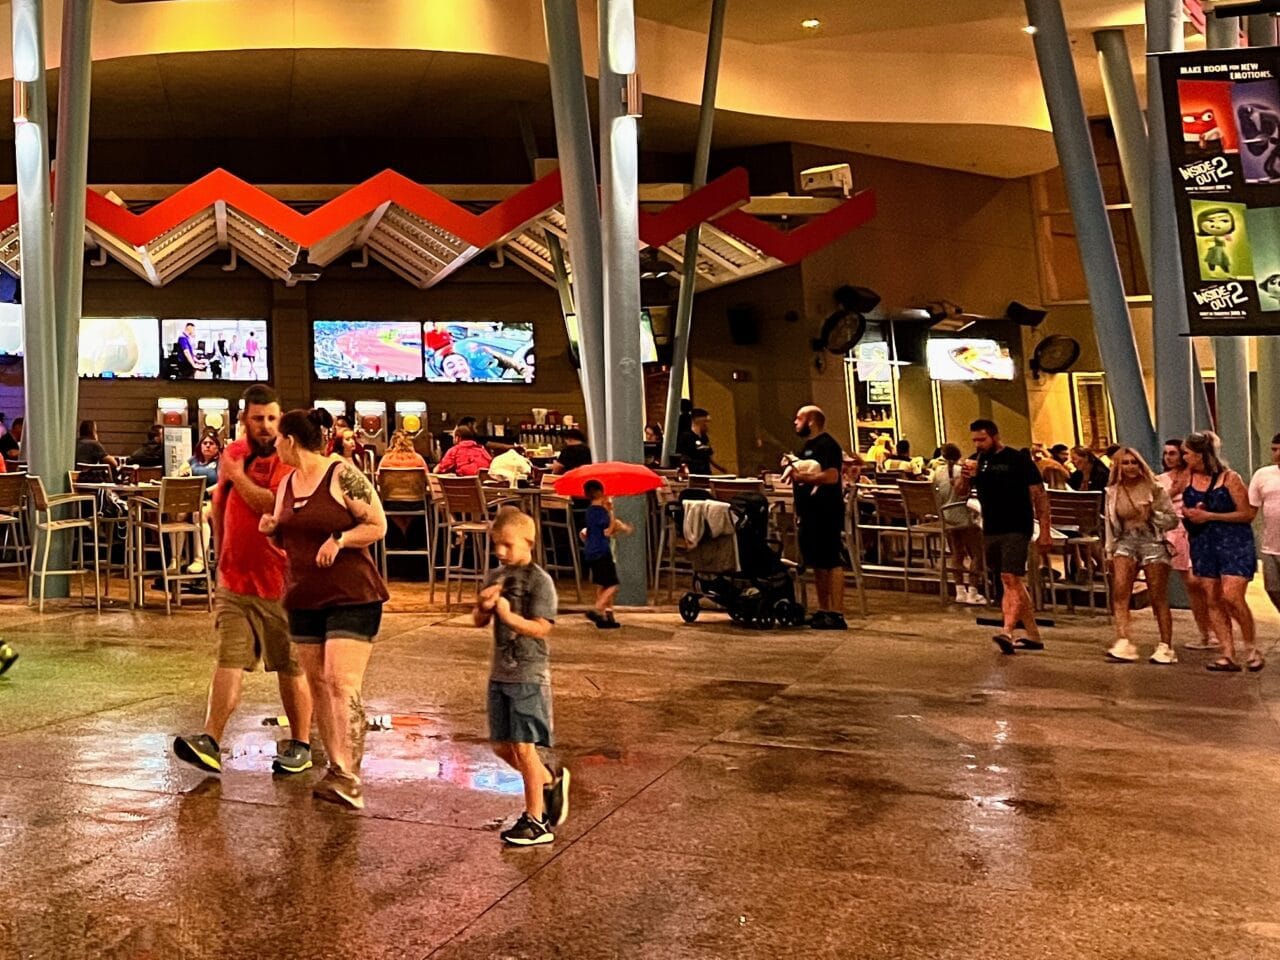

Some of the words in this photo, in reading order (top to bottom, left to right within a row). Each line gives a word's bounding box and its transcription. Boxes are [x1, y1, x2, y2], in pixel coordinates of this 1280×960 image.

[1179, 160, 1216, 181] INSIDE
[1195, 169, 1219, 186] OUT
[1211, 156, 1234, 178] 2
[1192, 285, 1230, 306] INSIDE
[1210, 294, 1234, 311] OUT
[1226, 281, 1249, 304] 2
